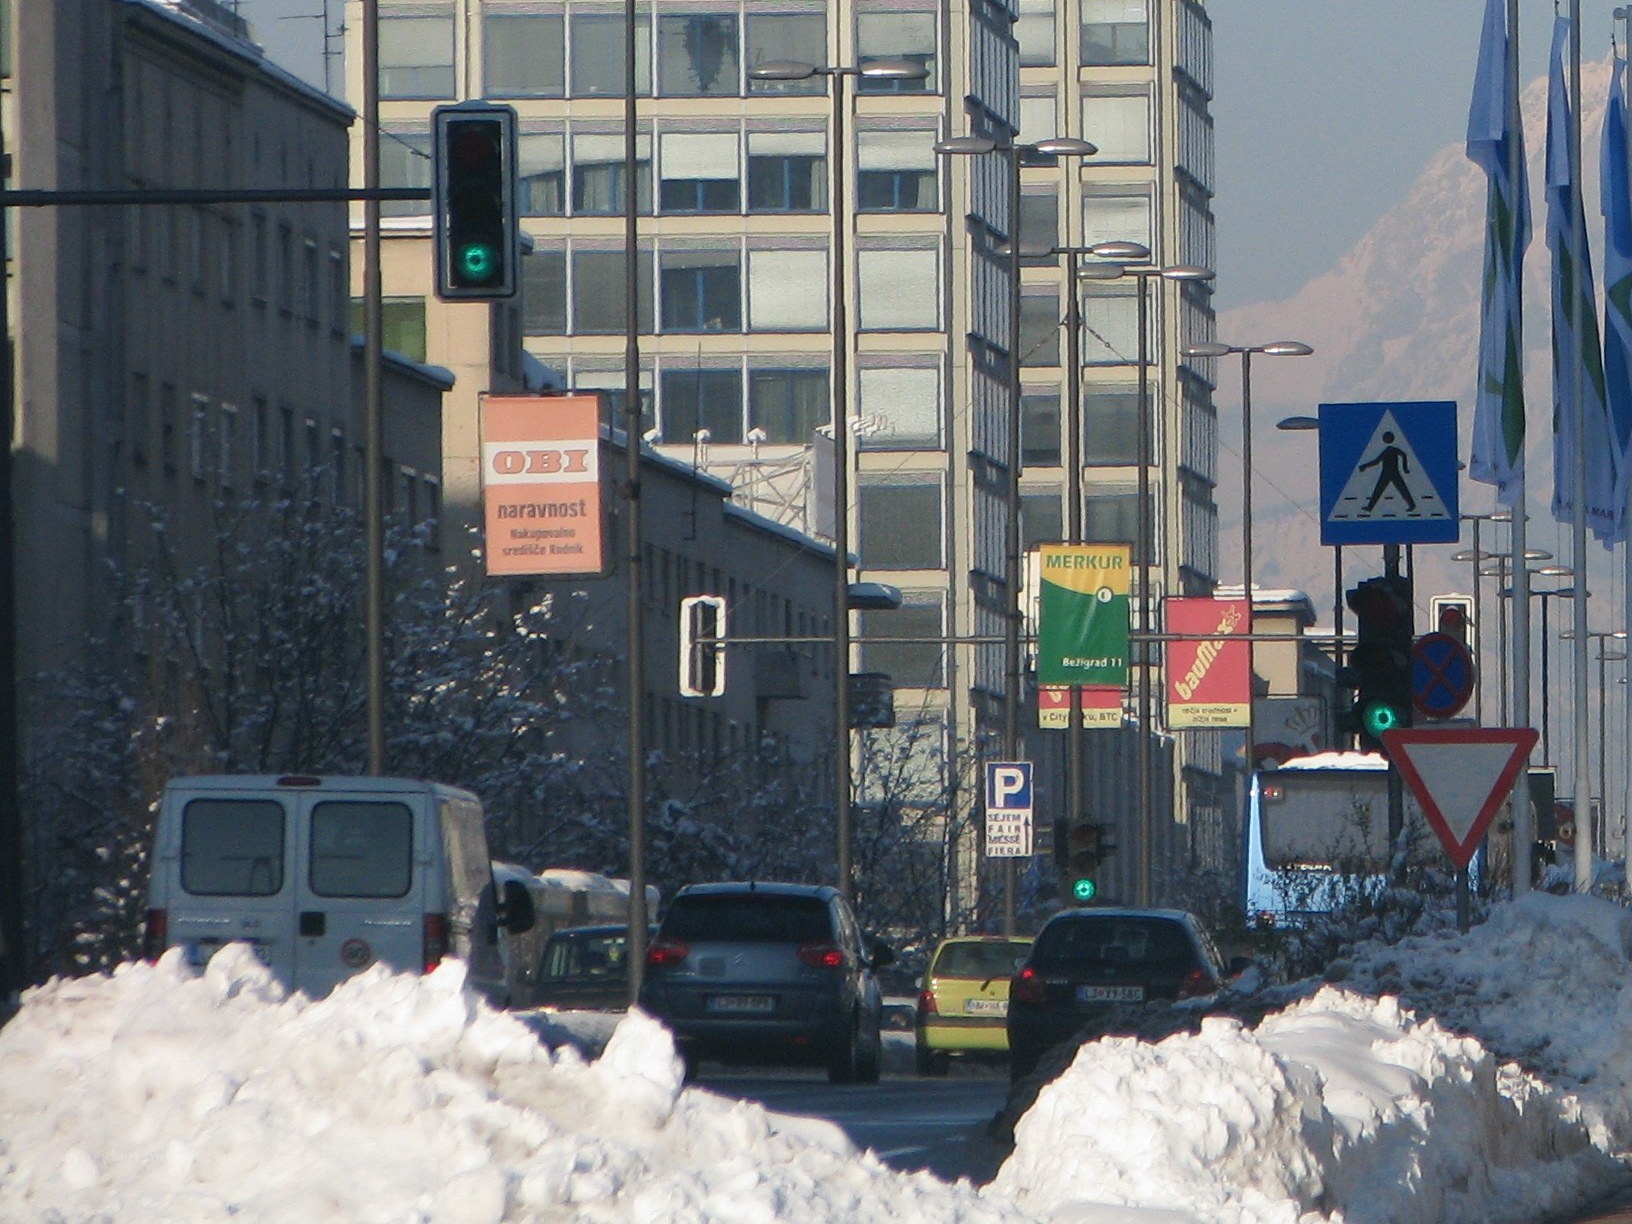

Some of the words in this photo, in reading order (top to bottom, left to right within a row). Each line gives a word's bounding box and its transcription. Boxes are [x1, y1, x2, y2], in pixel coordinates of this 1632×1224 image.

[492, 449, 588, 474] OBI
[498, 499, 587, 519] naravnost
[1046, 554, 1123, 570] MERKUR
[1110, 657, 1122, 668] 11
[995, 768, 1024, 808] P
[988, 825, 1020, 833] FAIR
